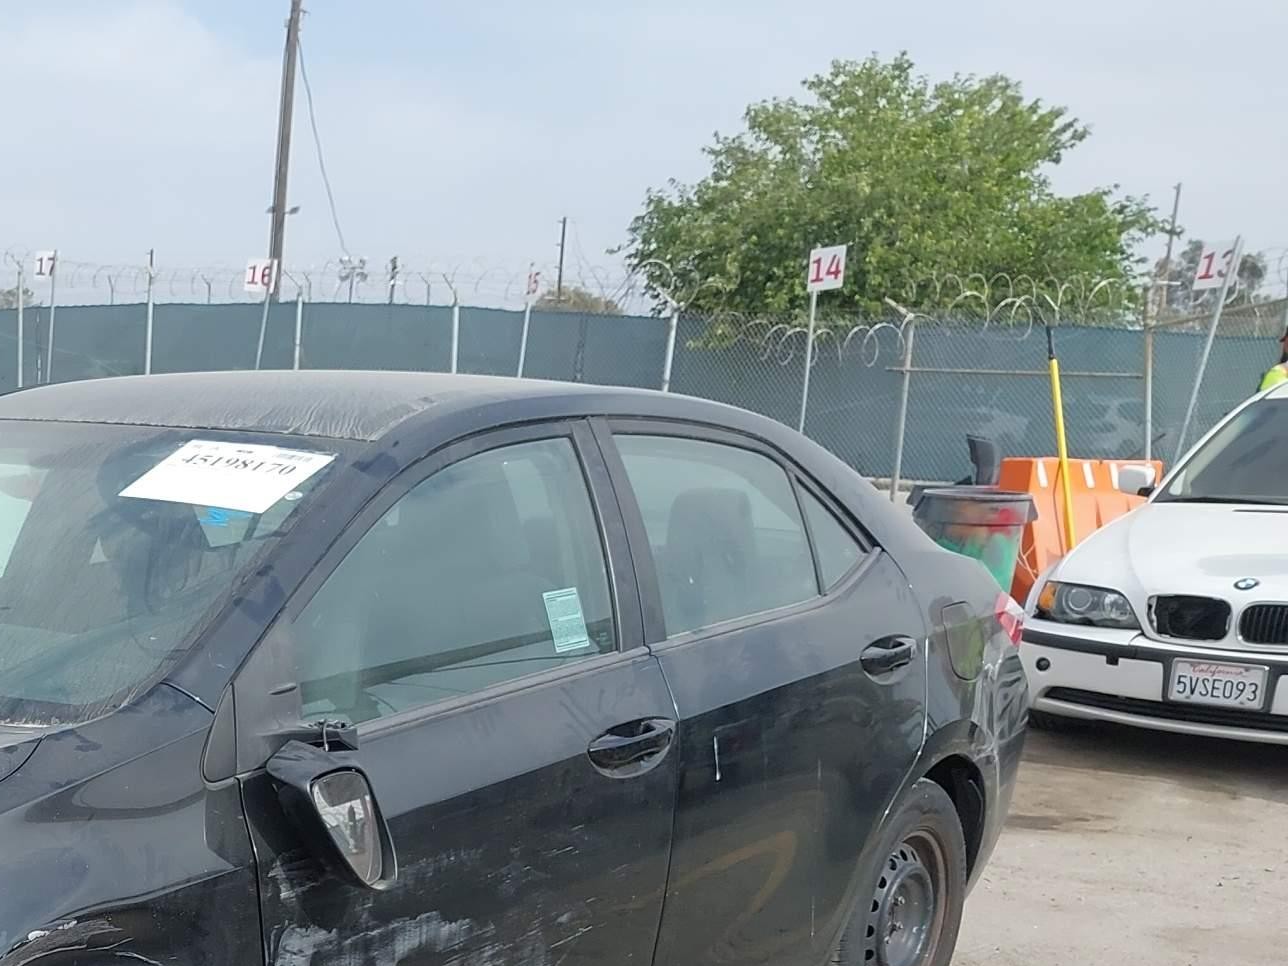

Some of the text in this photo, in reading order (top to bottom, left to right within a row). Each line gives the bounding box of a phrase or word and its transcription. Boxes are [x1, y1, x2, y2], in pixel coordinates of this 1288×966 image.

[35, 257, 56, 277] 17
[247, 265, 272, 288] 16
[810, 255, 841, 284] 14
[527, 272, 541, 296] 15
[182, 453, 297, 475] 45198170
[1192, 663, 1244, 677] California
[1176, 674, 1259, 702] 5VSE093
